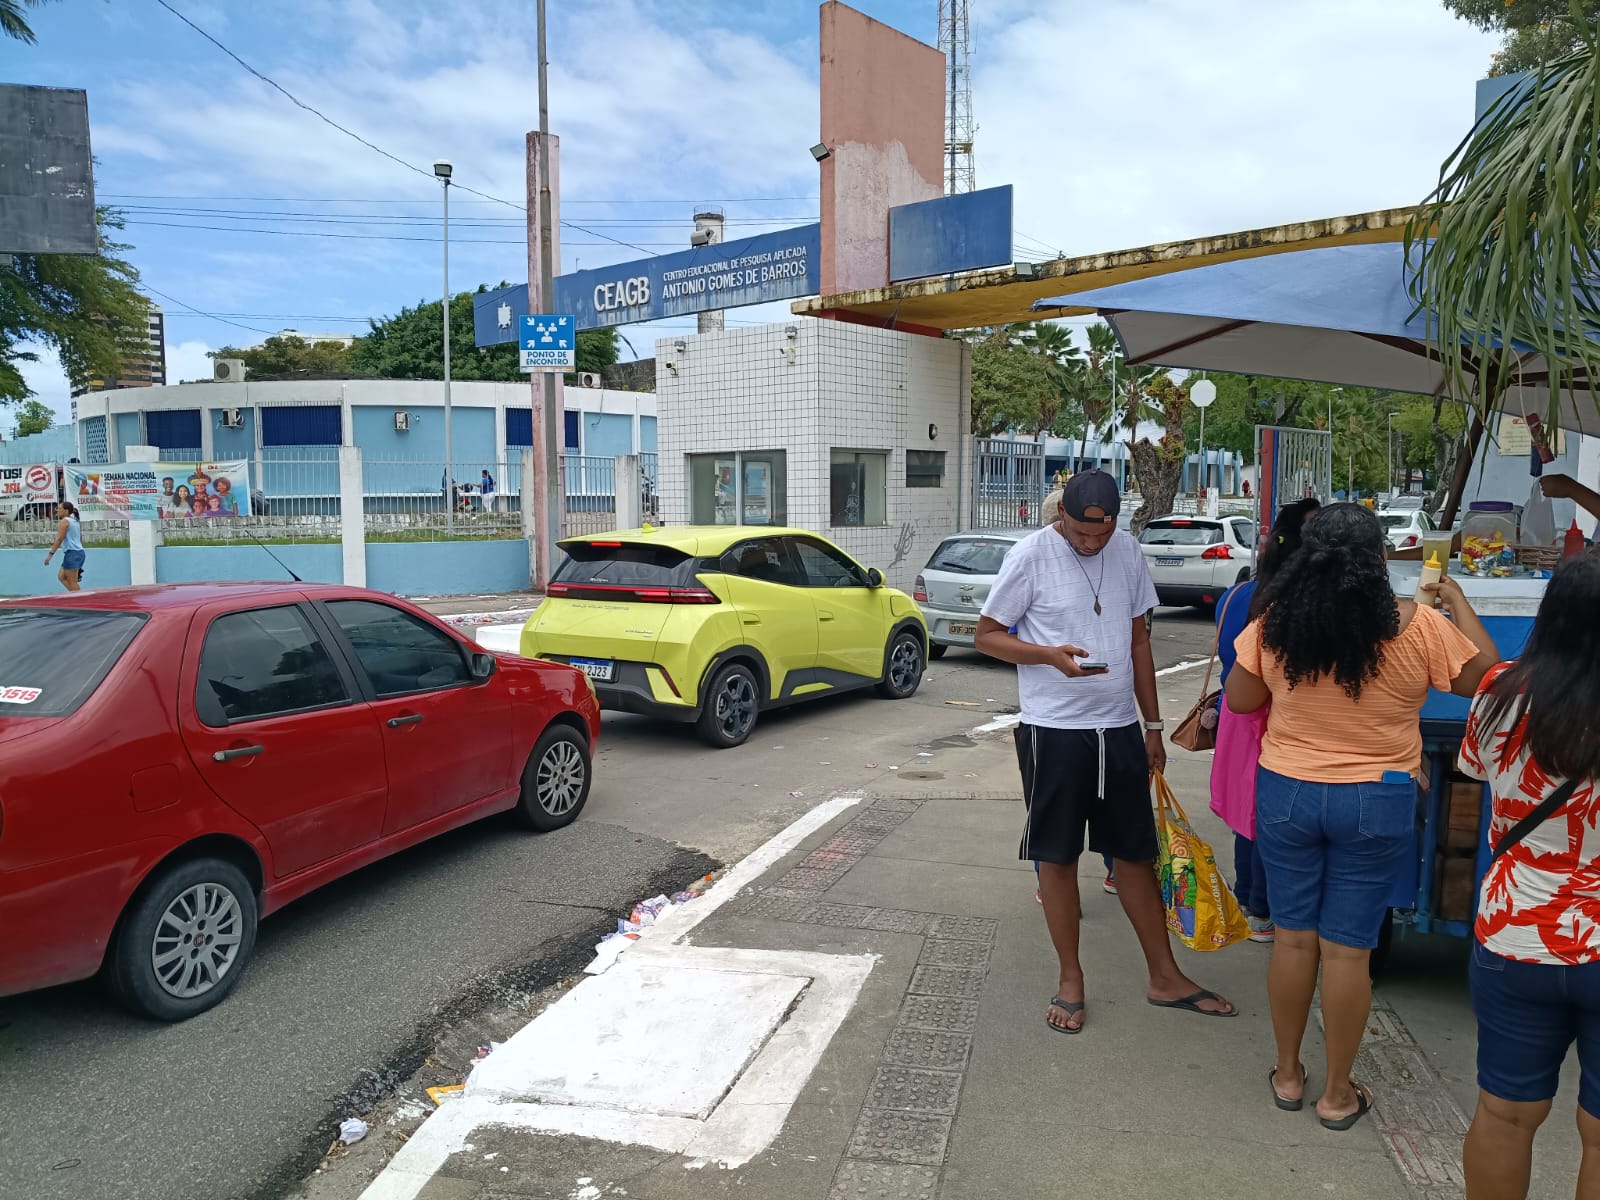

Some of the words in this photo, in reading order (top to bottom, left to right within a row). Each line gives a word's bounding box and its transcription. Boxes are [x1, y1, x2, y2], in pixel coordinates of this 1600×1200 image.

[662, 278, 706, 299] ANTONIO
[708, 271, 743, 291] GOMES
[745, 268, 759, 285] DE
[761, 259, 807, 282] BARROS
[663, 269, 687, 281] CENTRO
[687, 260, 730, 277] EDUCACIONAL
[730, 258, 740, 269] DE
[740, 252, 772, 268] PESQUISA
[773, 245, 807, 261] APLICADA
[593, 276, 650, 311] CEAGB
[104, 472, 125, 481] SEMANA
[125, 471, 157, 480] NACIONAL
